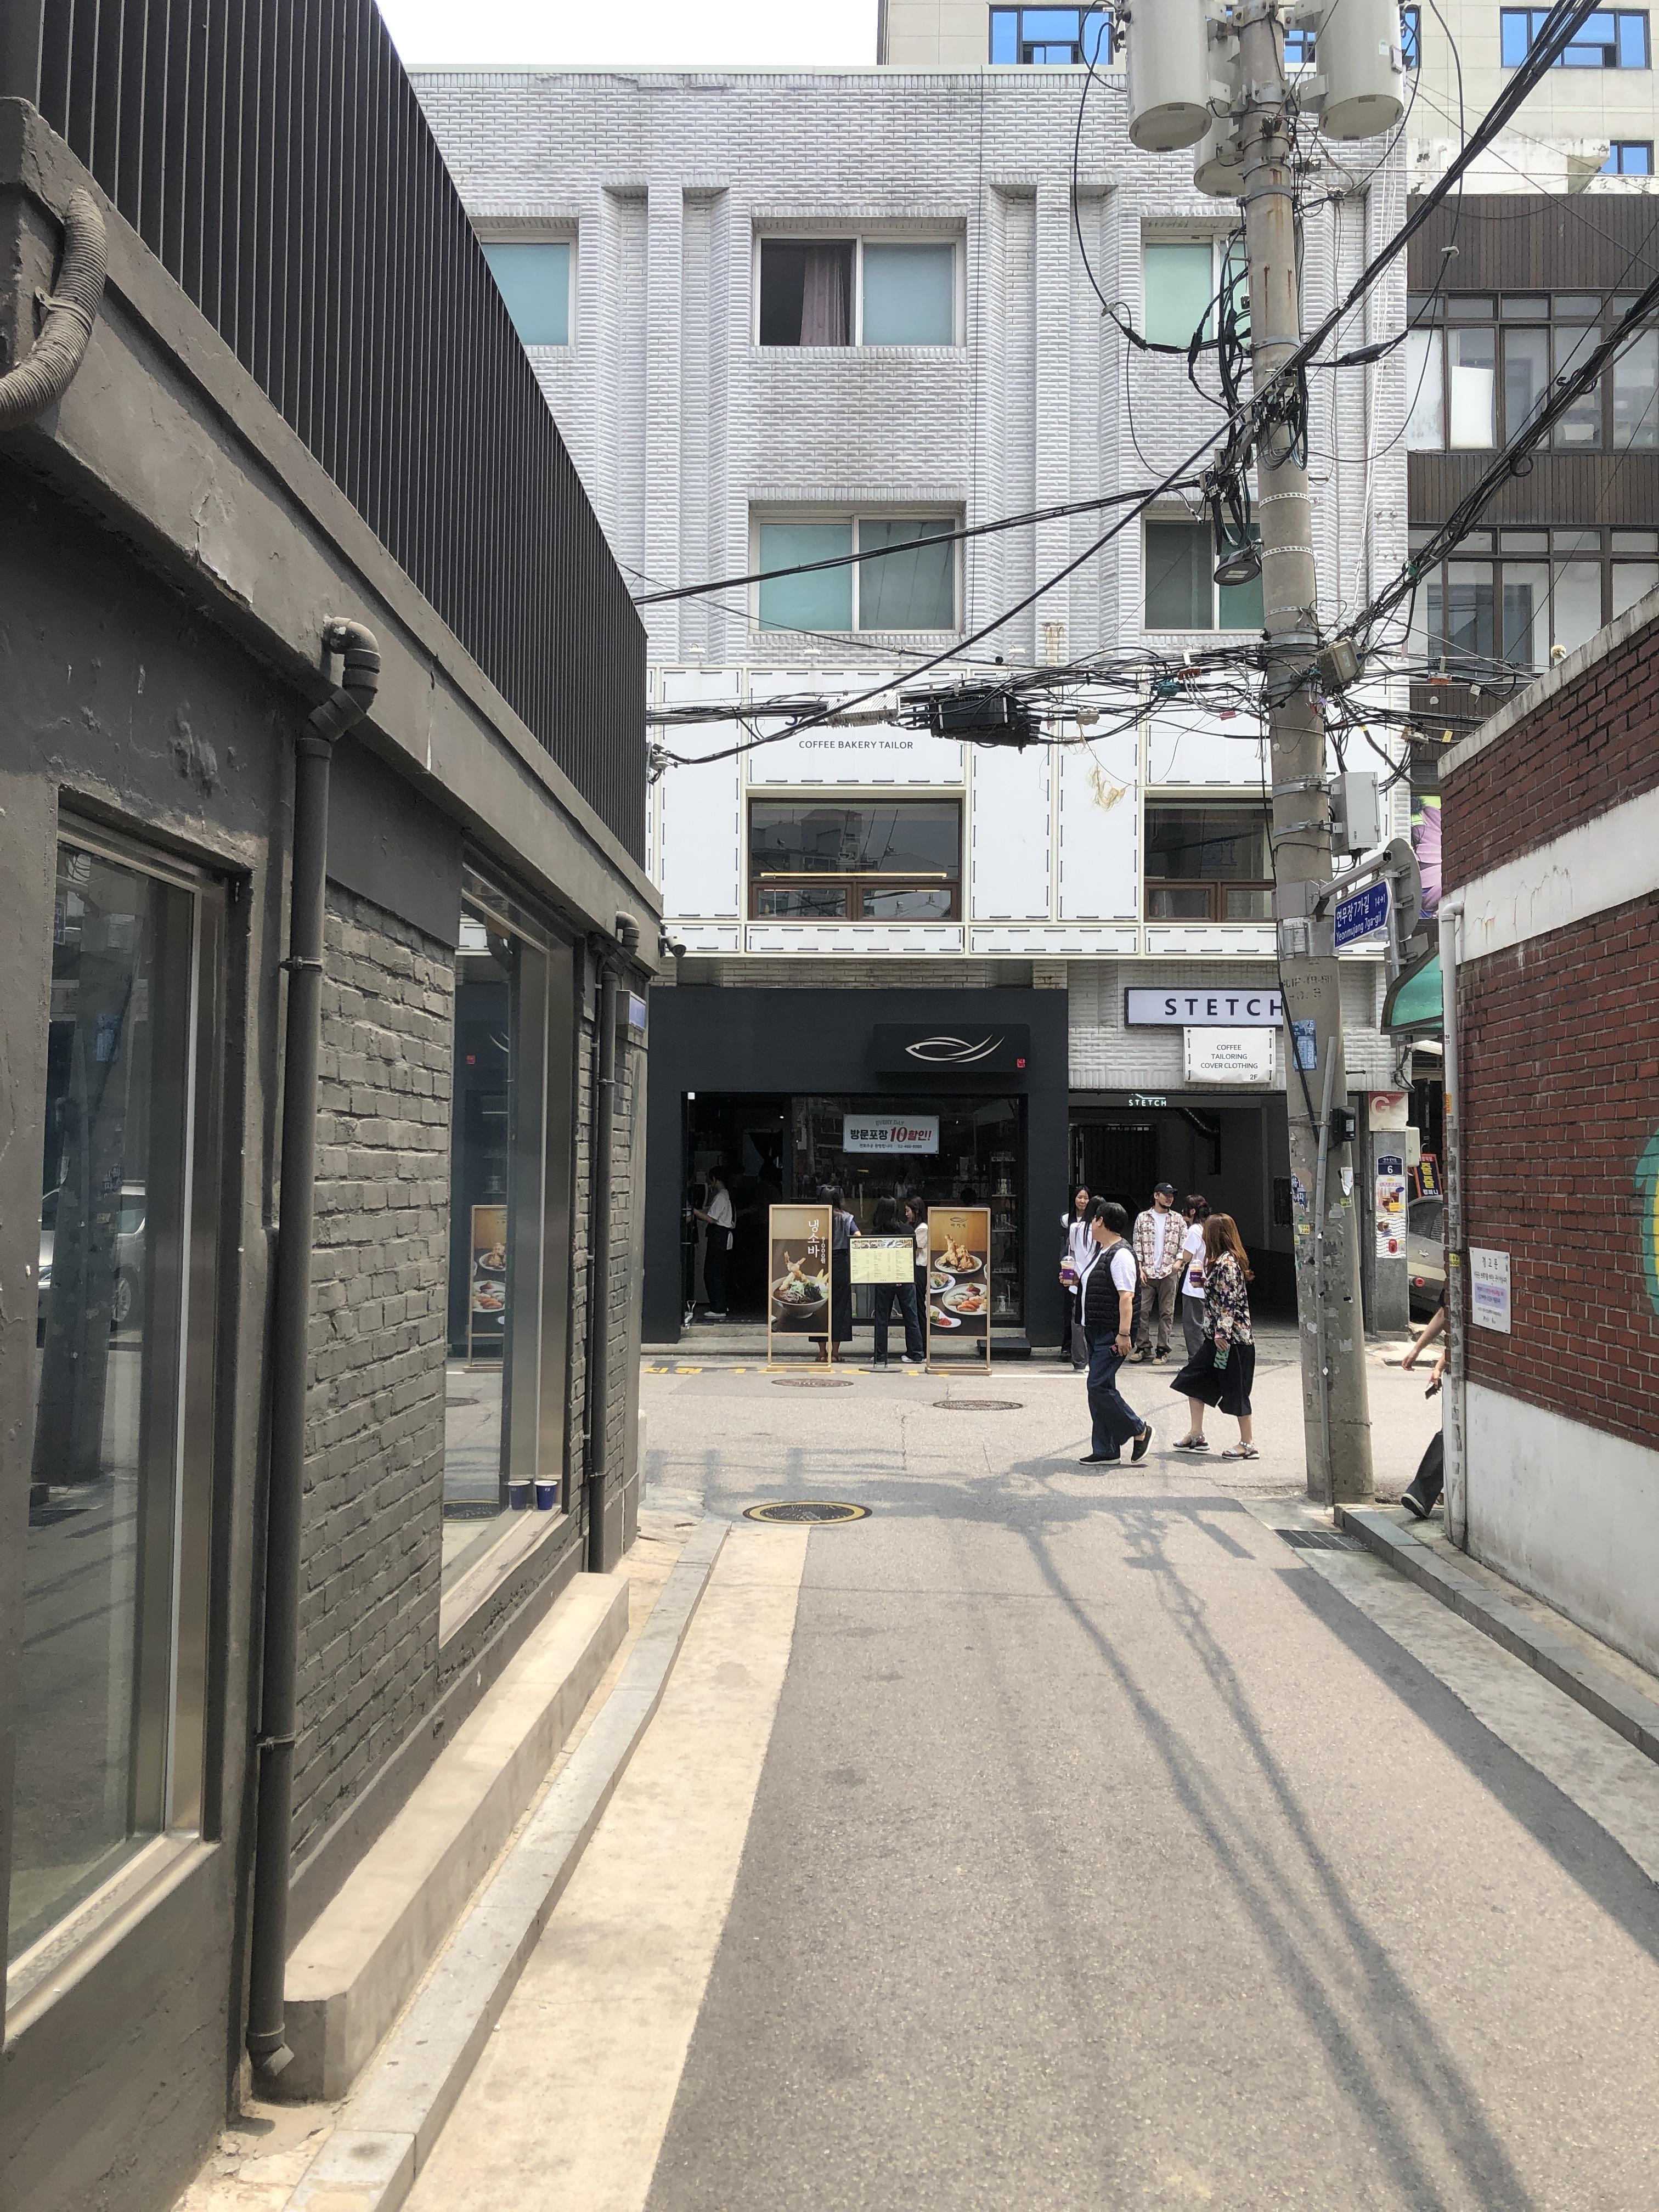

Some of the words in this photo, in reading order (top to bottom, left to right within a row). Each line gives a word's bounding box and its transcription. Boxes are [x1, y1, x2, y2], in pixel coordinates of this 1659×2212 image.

[799, 741, 835, 749] COFFEE
[838, 741, 877, 749] BAKERY
[879, 741, 913, 749] TAILOR
[1336, 894, 1369, 928] 연무장7가길
[1336, 923, 1364, 943] Yeonmujang
[1364, 910, 1381, 932] 7ga-gil
[1165, 998, 1283, 1016] STETCH
[850, 1129, 888, 1141] 방문포장
[1387, 1165, 1393, 1174] 6
[808, 1219, 820, 1259] 냉소바
